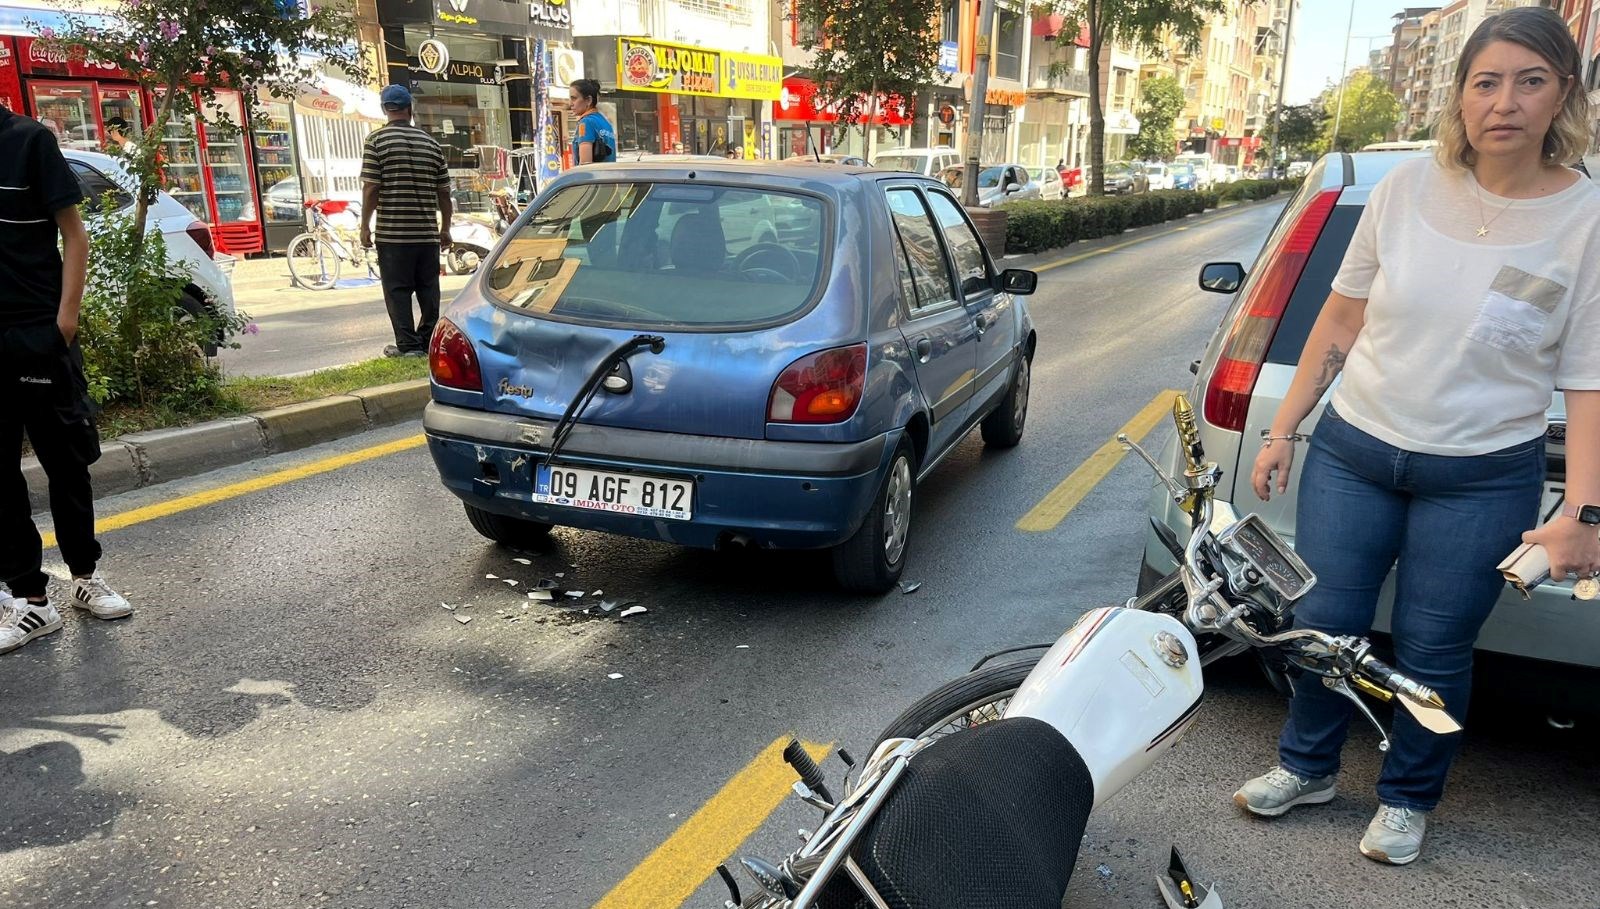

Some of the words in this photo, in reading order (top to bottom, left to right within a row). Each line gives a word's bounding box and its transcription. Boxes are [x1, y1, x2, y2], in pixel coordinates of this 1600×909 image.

[530, 3, 570, 23] PLUS
[737, 61, 758, 79] UYSAL
[759, 64, 780, 83] EMLAK
[539, 484, 549, 492] TR
[551, 471, 577, 498] 09
[588, 475, 630, 504] AGF
[641, 481, 685, 511] 812
[611, 504, 635, 513] OTO
